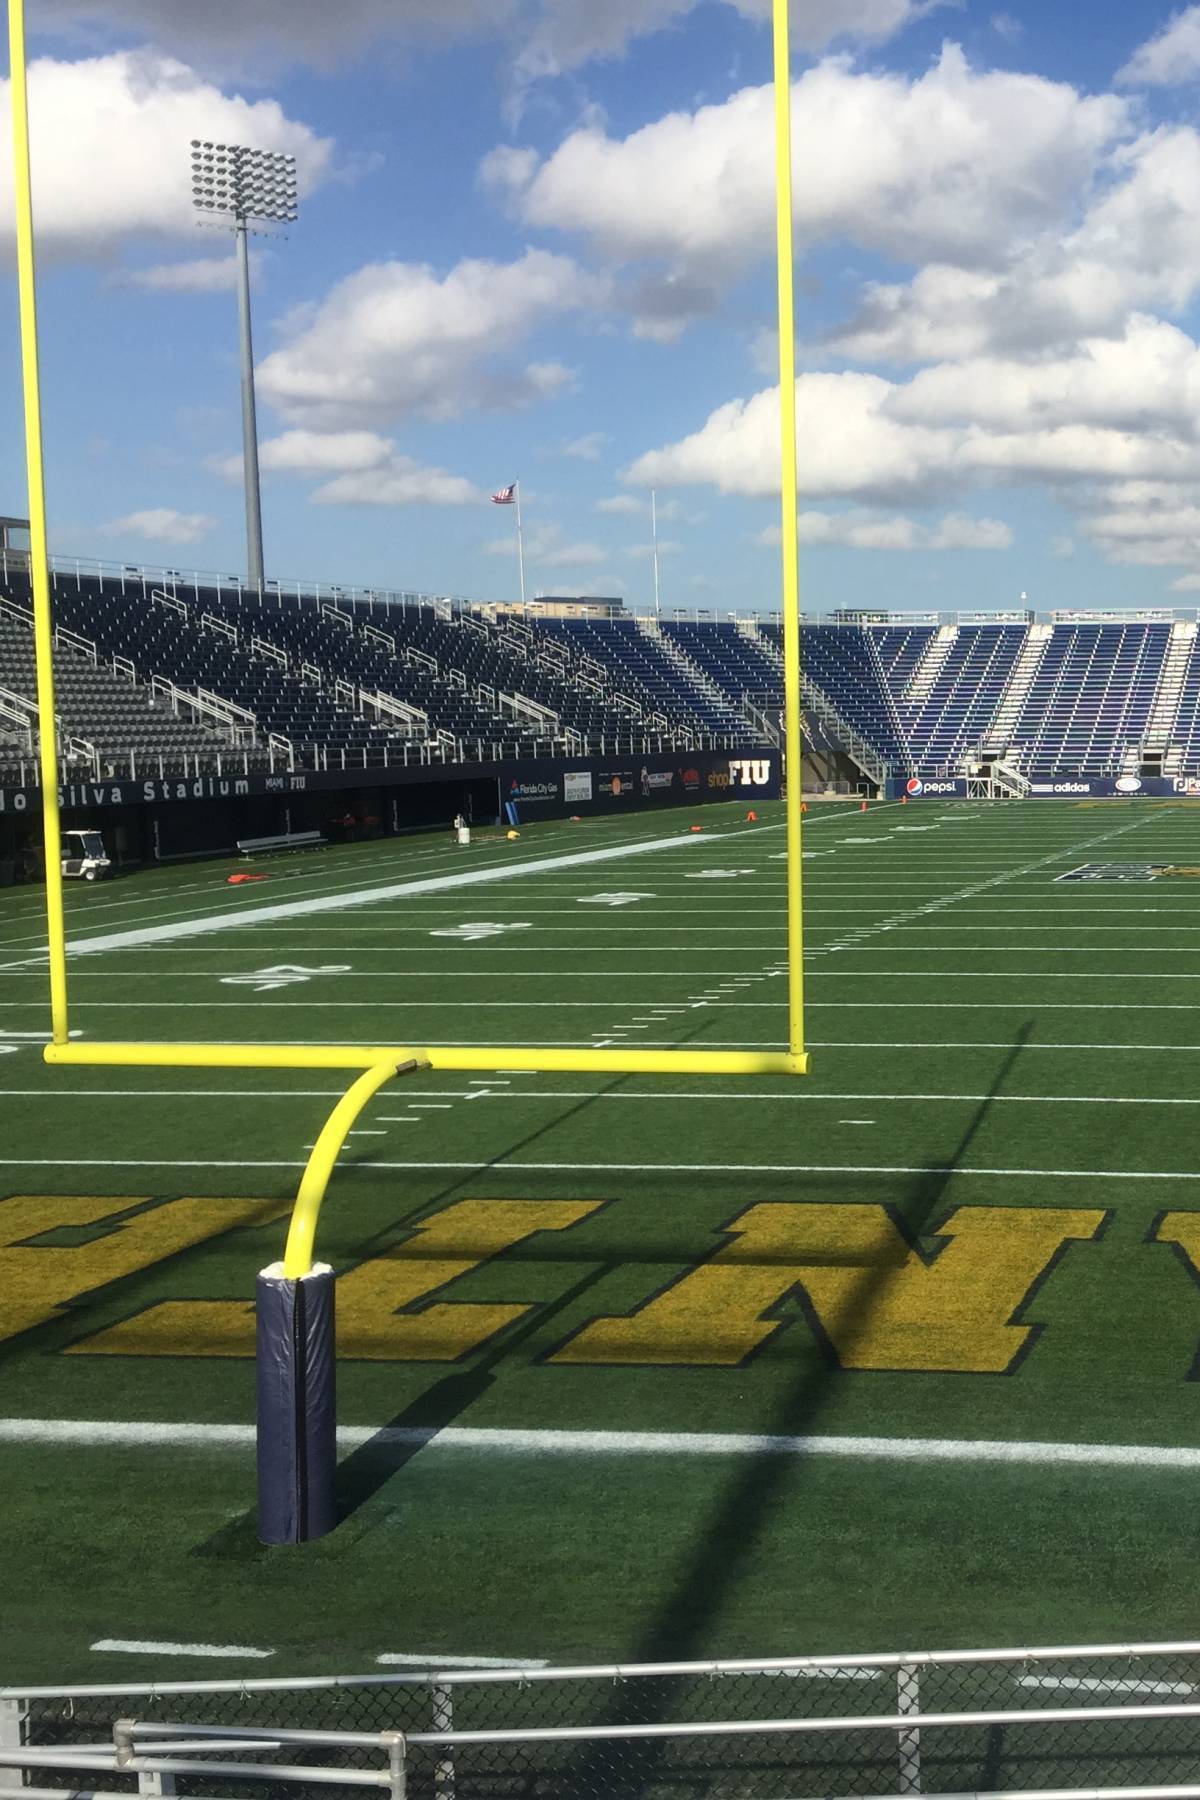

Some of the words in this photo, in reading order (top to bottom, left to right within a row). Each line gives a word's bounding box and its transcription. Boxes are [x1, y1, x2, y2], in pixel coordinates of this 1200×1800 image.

[144, 777, 250, 802] Stadium
[290, 776, 306, 790] FIU
[923, 781, 957, 794] pepsi
[1054, 782, 1090, 793] adidas
